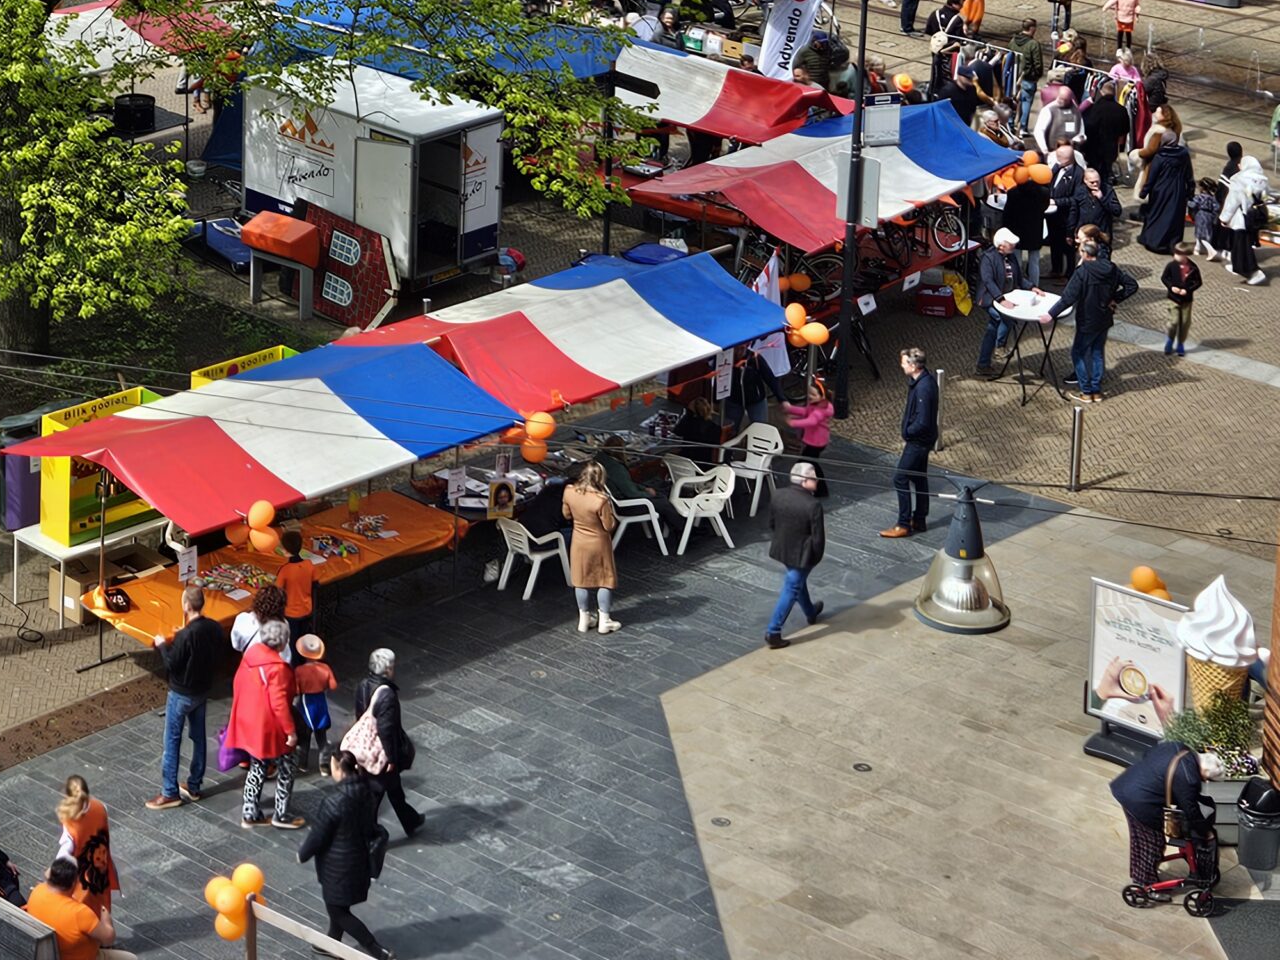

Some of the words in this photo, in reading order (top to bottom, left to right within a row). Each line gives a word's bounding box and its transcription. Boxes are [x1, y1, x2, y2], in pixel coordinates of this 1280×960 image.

[777, 7, 802, 71] Advendo
[240, 351, 275, 371] gooien
[63, 407, 88, 422] Blik
[91, 394, 128, 414] gooien
